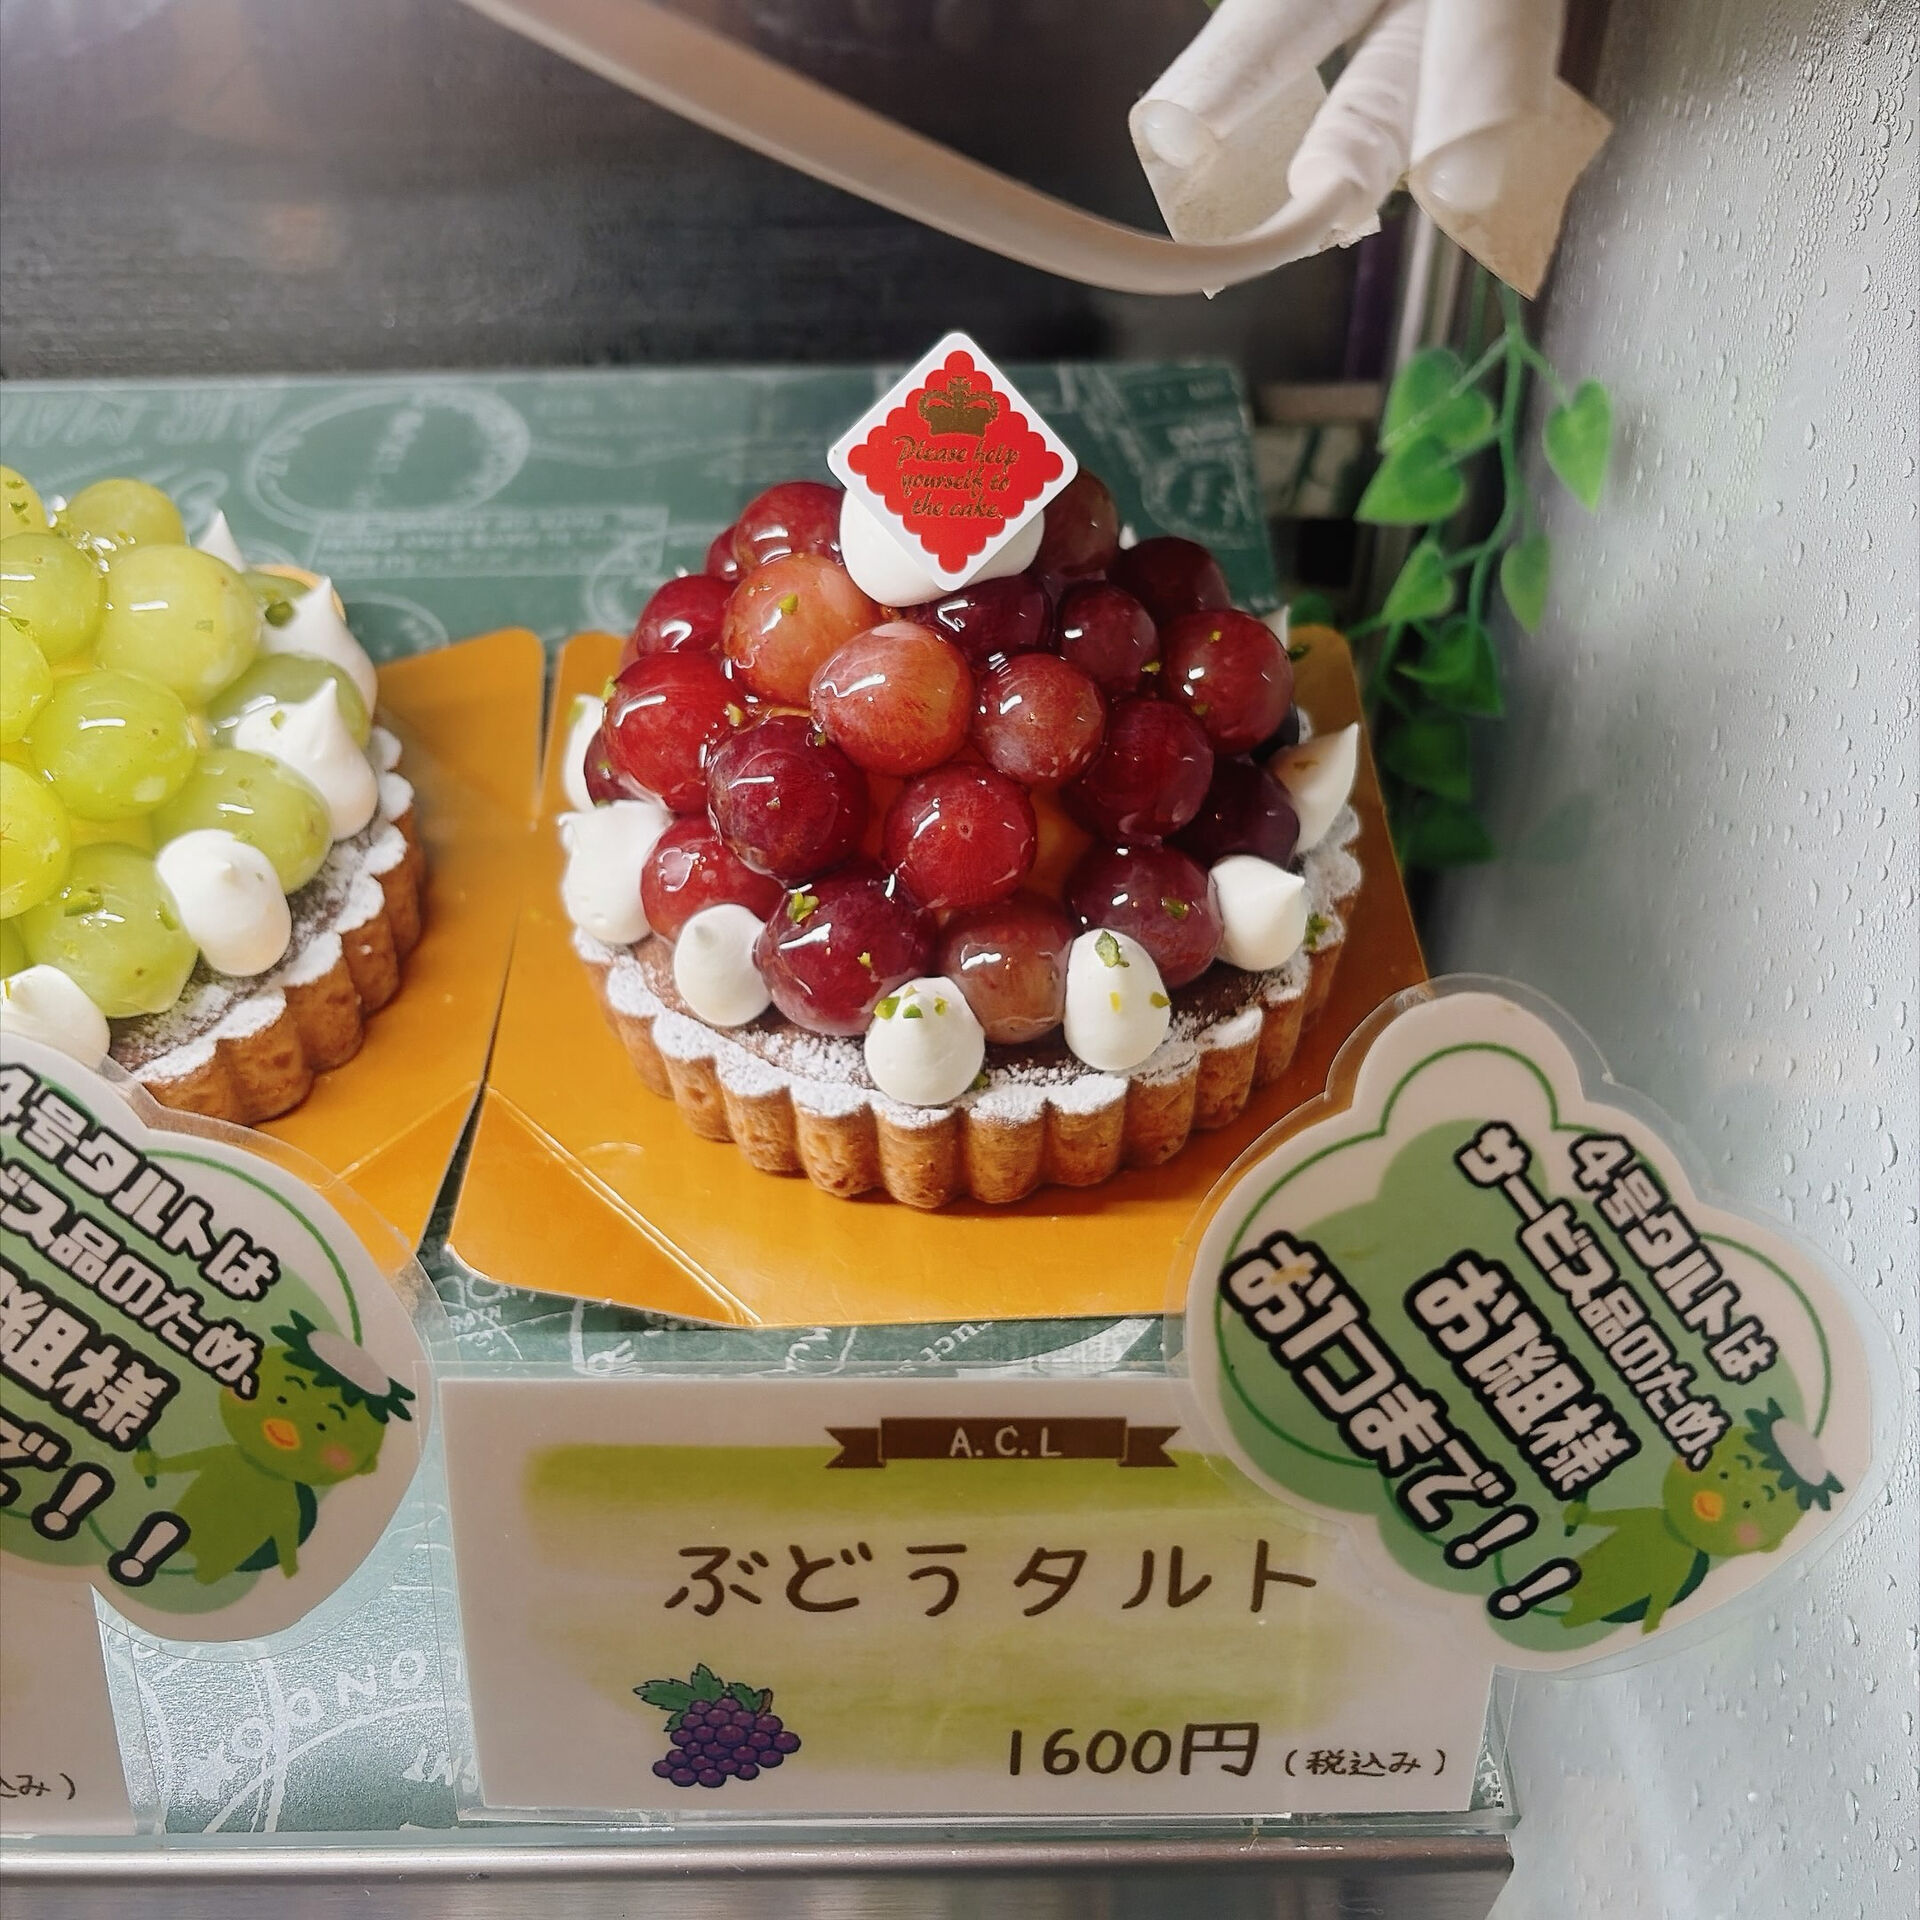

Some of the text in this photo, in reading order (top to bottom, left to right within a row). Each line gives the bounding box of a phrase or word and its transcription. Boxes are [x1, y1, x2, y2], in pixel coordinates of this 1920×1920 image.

[893, 435, 1019, 475] Please help
[902, 465, 1010, 498] yourself to
[912, 492, 943, 517] the
[1568, 1131, 1779, 1386] 4号タルトは
[1453, 1119, 1733, 1471] サービス品のため、
[0, 1267, 180, 1453] 組様
[1403, 1248, 1642, 1500] お1組様
[949, 1425, 1063, 1458] A.C.L
[664, 1538, 1317, 1618] ぶどうタルト
[1008, 1721, 1447, 1778] 1600円 （税込み）
